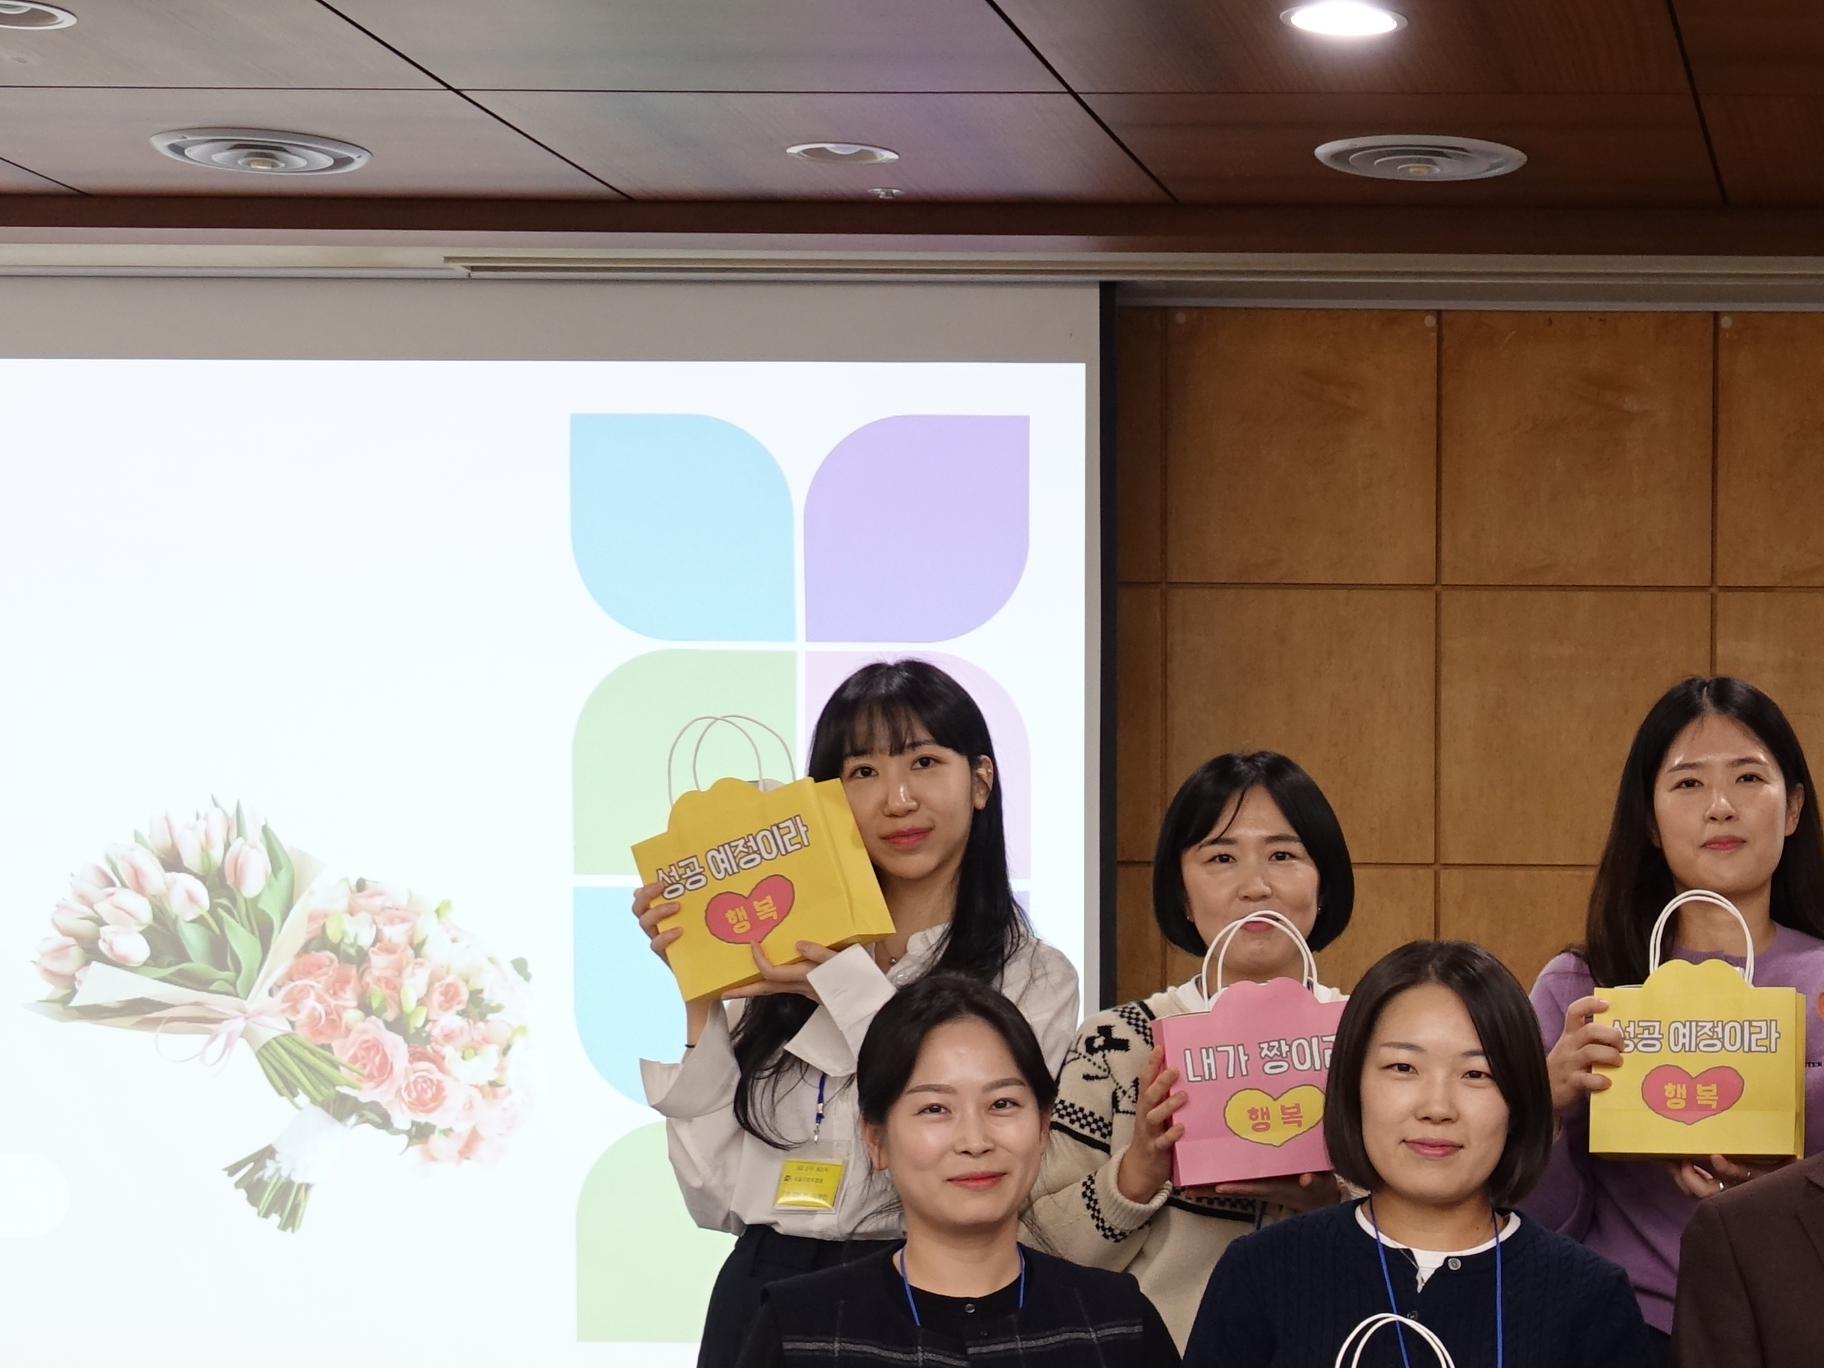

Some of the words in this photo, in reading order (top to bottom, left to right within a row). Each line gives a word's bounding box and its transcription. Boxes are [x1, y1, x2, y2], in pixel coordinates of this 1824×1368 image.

[656, 855, 707, 900] 성공
[705, 814, 810, 881] 예정이라
[1668, 1019, 1780, 1053] 예정이라
[1184, 1043, 1250, 1083] 내가
